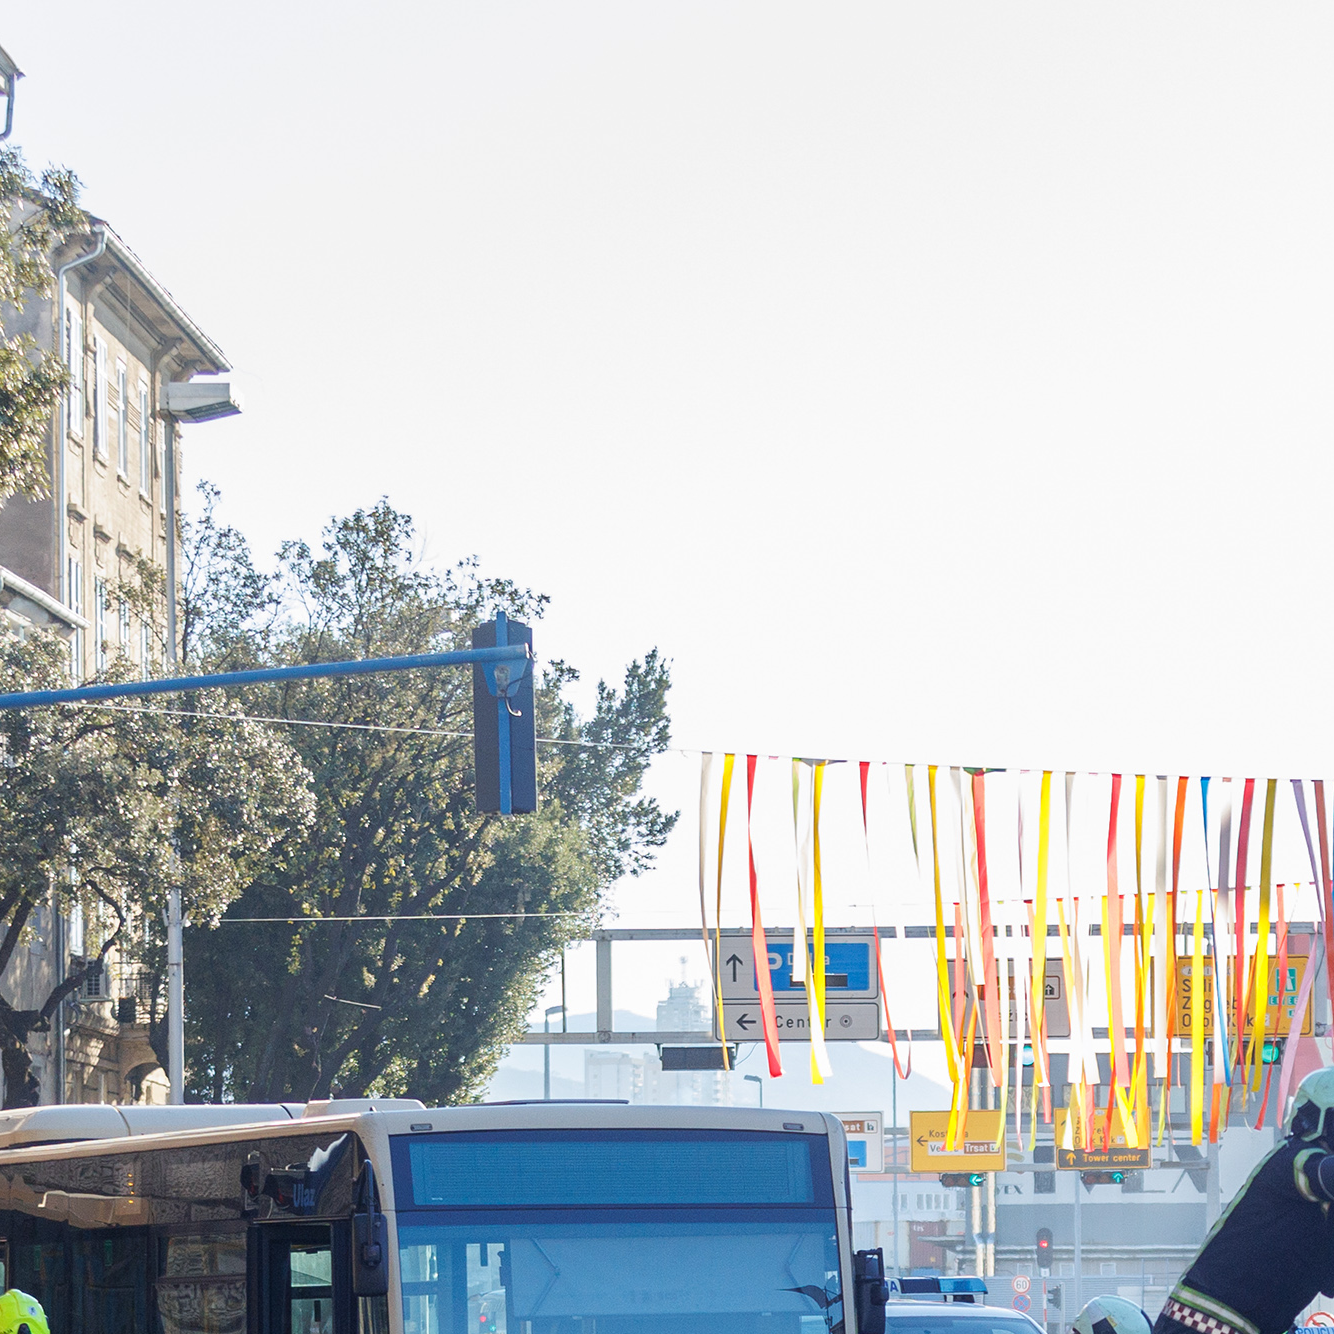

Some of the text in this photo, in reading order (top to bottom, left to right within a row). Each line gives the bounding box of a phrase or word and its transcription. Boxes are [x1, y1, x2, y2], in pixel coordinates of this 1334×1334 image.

[776, 1015, 832, 1028] Centr
[965, 1143, 989, 1153] Trsat
[1083, 1154, 1141, 1162] Tower center
[293, 1184, 315, 1207] Ulaz
[1016, 1280, 1027, 1290] 60
